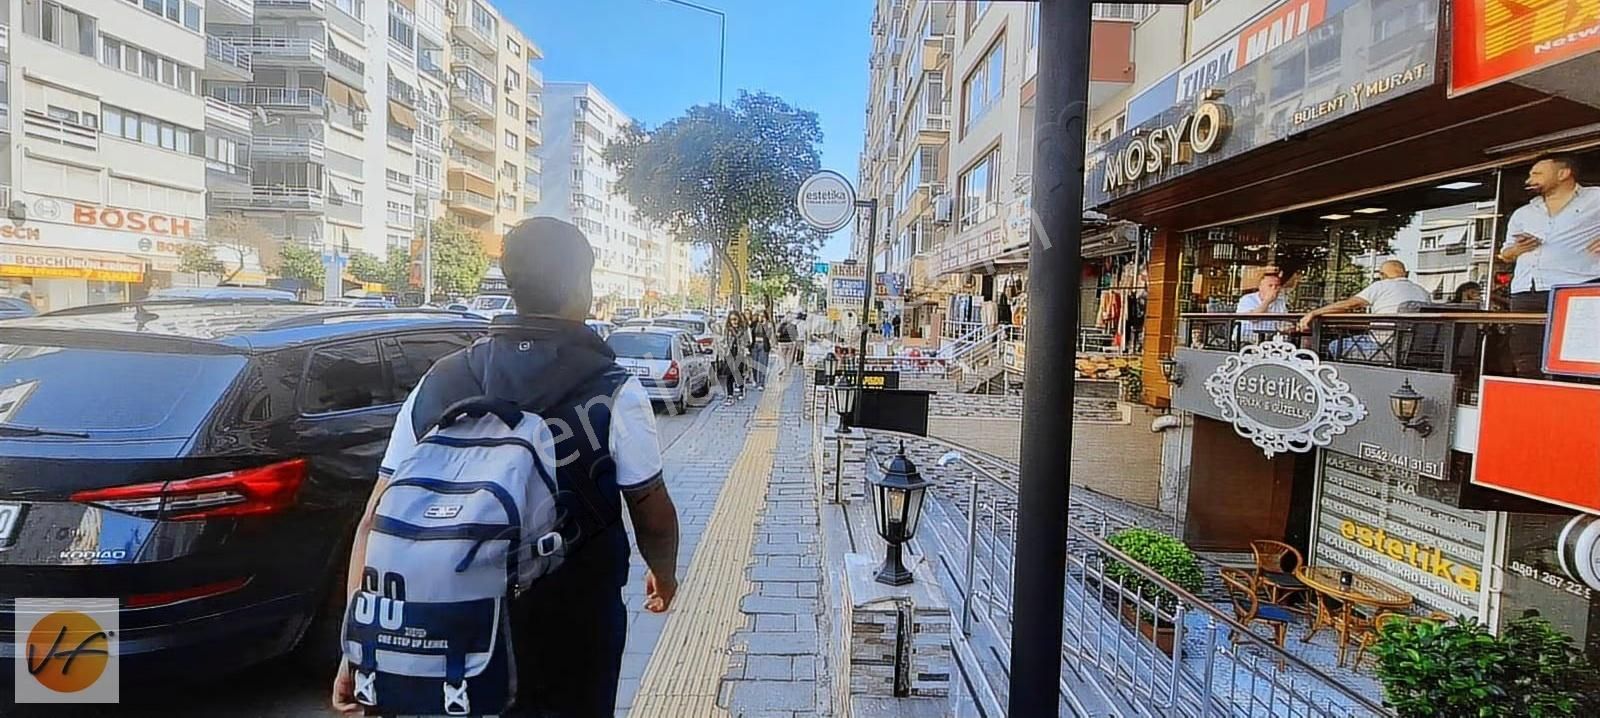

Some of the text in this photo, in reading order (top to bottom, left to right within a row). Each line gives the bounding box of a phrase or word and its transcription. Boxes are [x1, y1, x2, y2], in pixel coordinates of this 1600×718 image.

[1366, 63, 1428, 98] MURAT
[1102, 88, 1228, 193] MÖSYÖ
[73, 204, 191, 237] BOSCH
[1237, 374, 1316, 404] estetika
[1364, 447, 1388, 462] 0542
[1411, 459, 1422, 471] 31
[1425, 462, 1438, 475] 51
[1340, 517, 1479, 592] estetika
[1511, 561, 1538, 579] 0501
